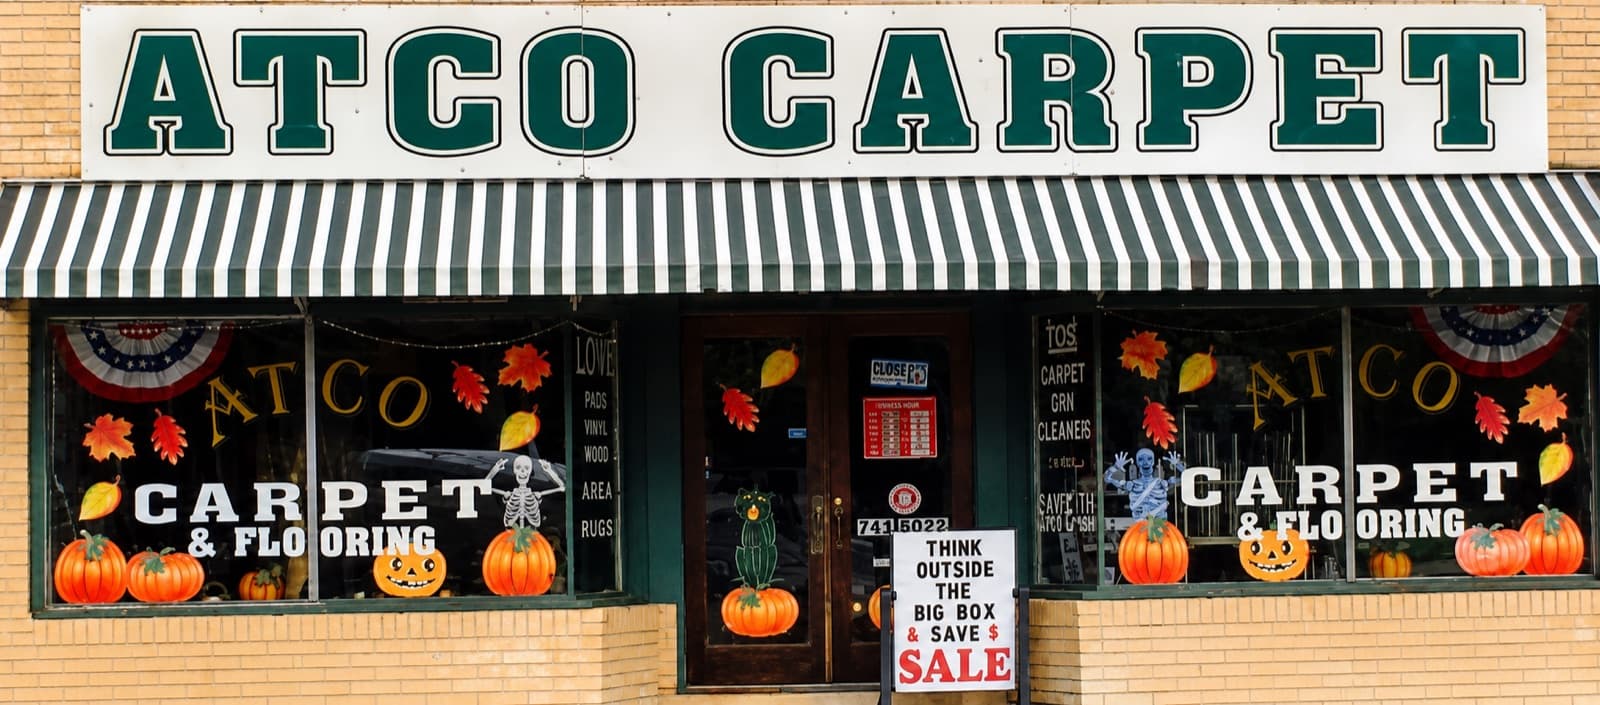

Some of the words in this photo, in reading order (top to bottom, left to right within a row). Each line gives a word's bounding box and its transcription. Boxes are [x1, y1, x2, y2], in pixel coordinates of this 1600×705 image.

[103, 25, 637, 157] ATCO
[721, 26, 1527, 157] CARPET
[1041, 362, 1085, 386] CARPET
[1246, 343, 1462, 432] ATCO
[205, 358, 431, 447] ATCO
[584, 391, 607, 409] PADS
[1051, 392, 1074, 413] GRN
[584, 419, 608, 437] VINYL
[584, 446, 609, 463] WOOD
[582, 481, 612, 500] AREA
[1181, 461, 1518, 507] CARPET
[134, 478, 492, 524] CARPET
[581, 519, 613, 538] RUGS
[859, 519, 894, 534] 741
[900, 518, 947, 533] 5022
[1237, 511, 1264, 541] &
[1276, 508, 1465, 541] FLOORING
[187, 527, 216, 558] &
[234, 525, 436, 557] FLOORING
[926, 539, 982, 557] THINK
[917, 560, 994, 579] OUTSIDE
[935, 582, 971, 600] THE
[914, 604, 944, 621] BIG
[957, 603, 995, 620] BOX
[907, 626, 919, 642] &
[931, 625, 980, 642] SAVE
[989, 623, 999, 641] $
[899, 647, 1011, 684] SALE
